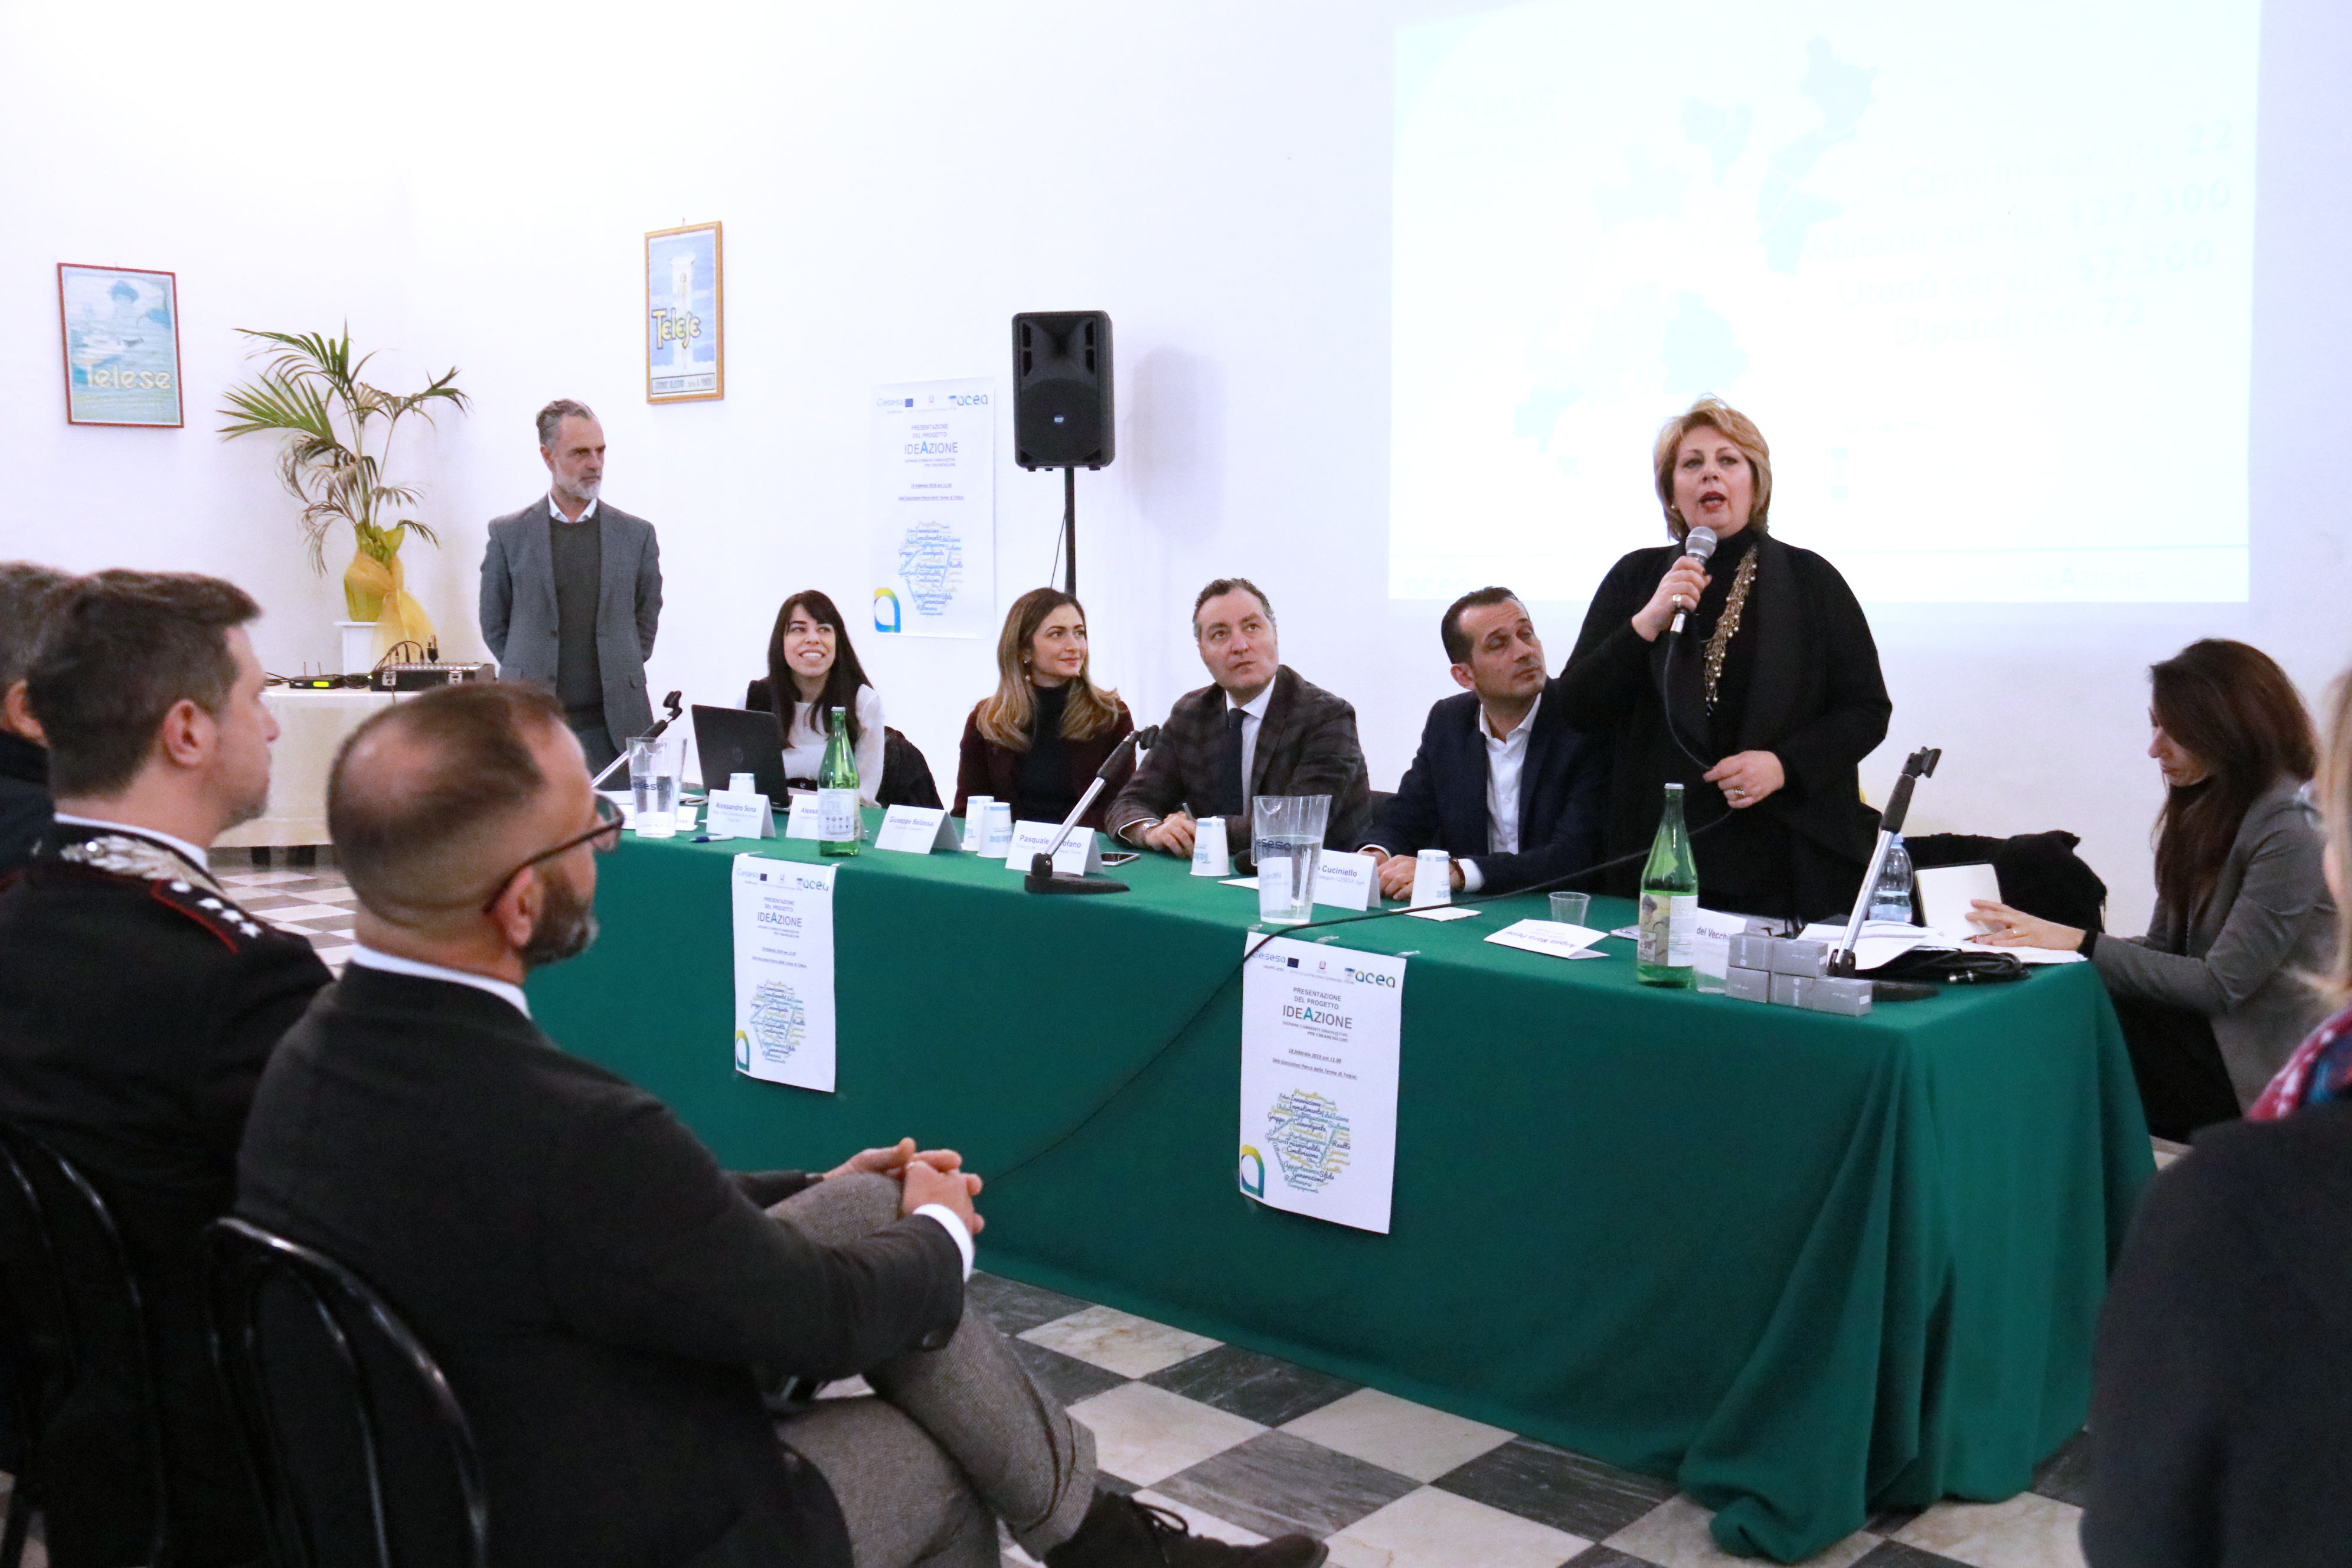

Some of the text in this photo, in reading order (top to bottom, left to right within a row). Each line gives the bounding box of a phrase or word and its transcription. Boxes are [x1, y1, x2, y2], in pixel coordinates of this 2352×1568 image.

[2184, 119, 2235, 156] 22
[2098, 295, 2144, 326] 72
[652, 308, 701, 349] Telese
[77, 358, 171, 390] Telese
[958, 394, 988, 406] acea
[904, 441, 958, 454] IDEAZIONE
[716, 802, 743, 811] Alessandro
[889, 816, 912, 825] Giuseppe
[1020, 834, 1049, 845] Pasquale
[1322, 865, 1357, 878] Cuciniello
[757, 912, 802, 927] IDEAZIONE
[1697, 926, 1707, 935] del
[1355, 971, 1396, 988] acea
[1293, 987, 1341, 1001] PRESENTAZIONE
[1307, 998, 1339, 1010] PROGETTO
[1283, 1005, 1353, 1029] IDEAZIONE
